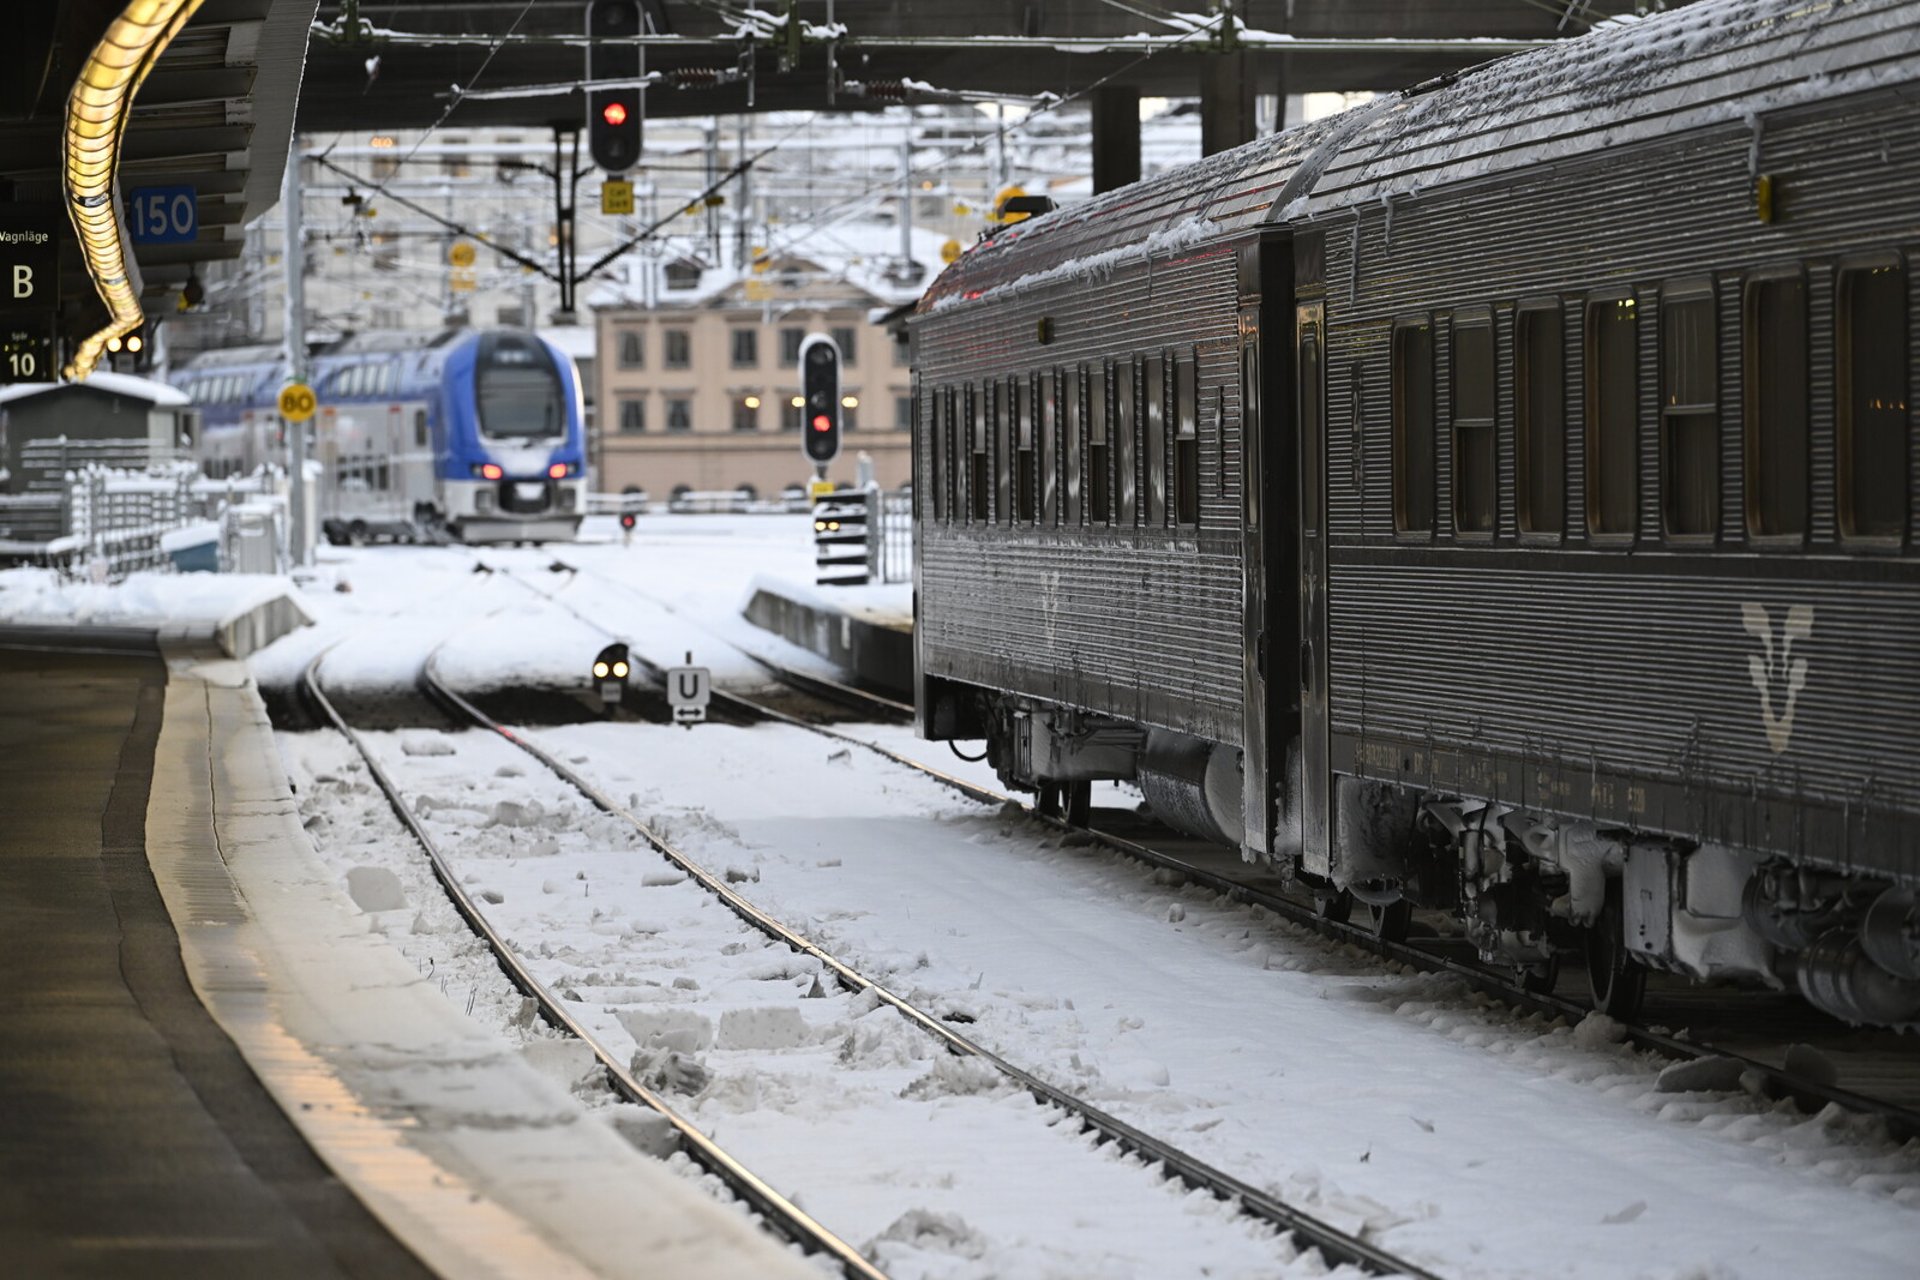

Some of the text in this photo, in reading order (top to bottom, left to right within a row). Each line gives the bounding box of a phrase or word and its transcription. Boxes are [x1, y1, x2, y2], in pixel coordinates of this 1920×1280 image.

[134, 195, 193, 235] 150
[0, 231, 48, 244] Vagnläge
[13, 265, 34, 299] B
[9, 353, 36, 377] 10
[680, 674, 697, 699] U
